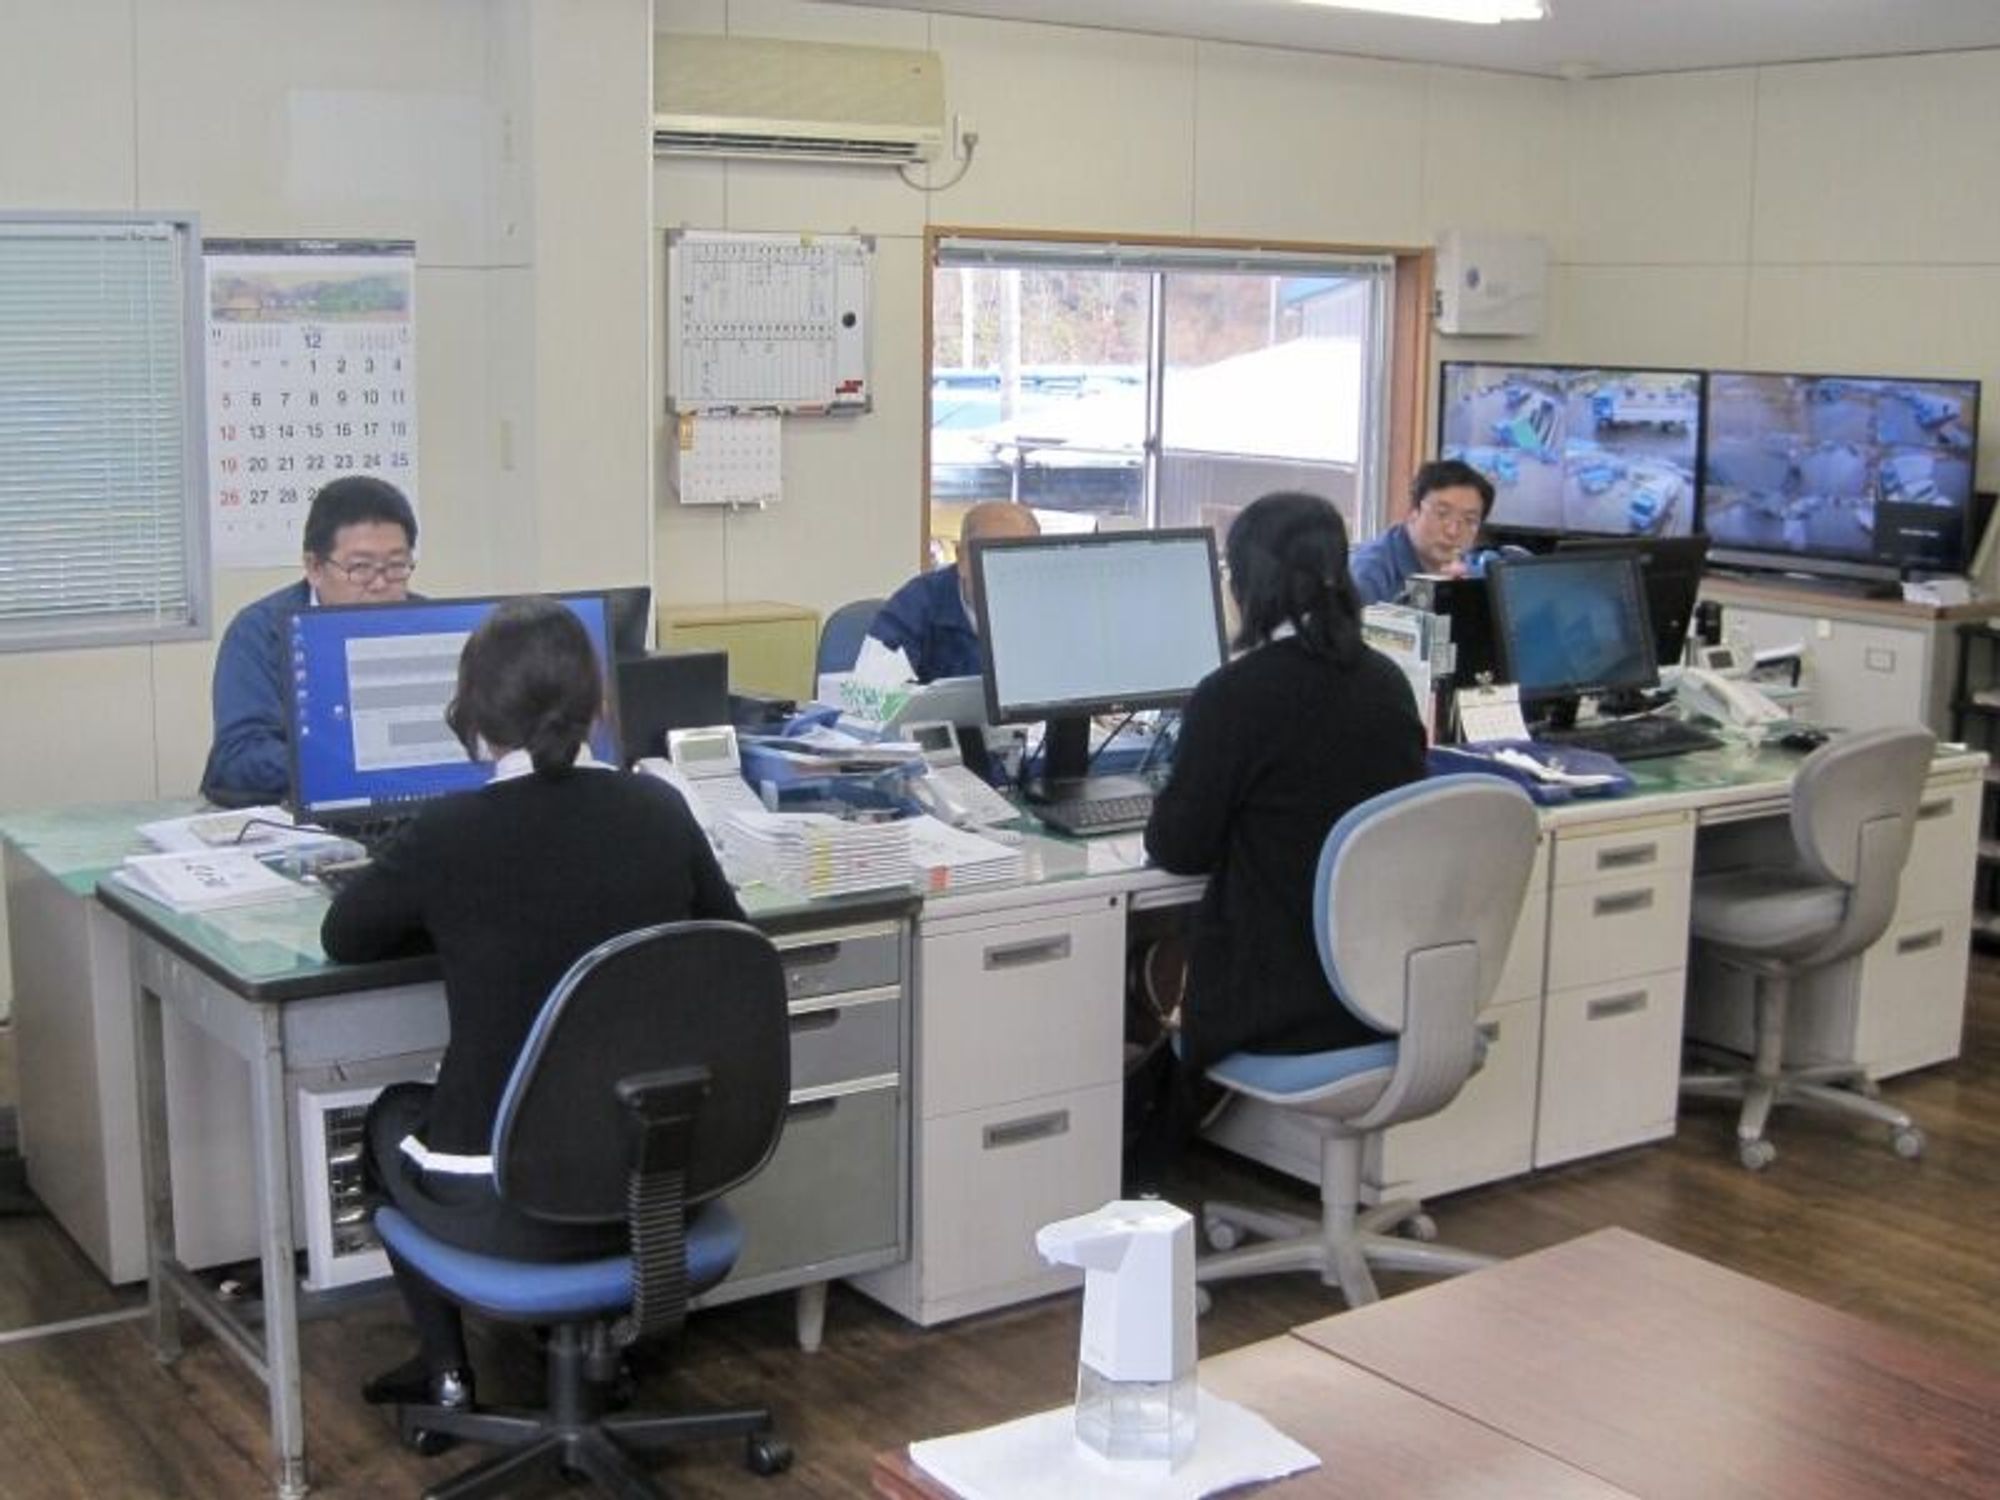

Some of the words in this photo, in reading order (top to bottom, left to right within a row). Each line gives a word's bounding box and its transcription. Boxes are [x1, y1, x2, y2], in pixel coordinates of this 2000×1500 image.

[305, 333, 321, 349] 12
[309, 359, 316, 374] 1
[337, 358, 346, 373] 2
[365, 358, 374, 373] 3
[393, 358, 402, 371] 4
[223, 392, 231, 409] 5
[252, 392, 261, 406] 6
[280, 392, 290, 407] 7
[310, 391, 318, 406] 8
[337, 390, 346, 405] 9
[363, 389, 378, 404] 10
[392, 389, 404, 404] 11
[220, 426, 236, 441] 12
[249, 426, 265, 440] 13
[279, 425, 294, 439] 14
[307, 425, 323, 438] 15
[336, 423, 351, 437] 16
[364, 423, 378, 436] 17
[392, 422, 406, 437] 18
[220, 458, 236, 474] 19
[249, 457, 267, 472] 20
[279, 456, 294, 471] 21
[307, 455, 324, 470] 22
[335, 454, 353, 469] 23
[363, 454, 381, 468] 24
[391, 453, 409, 467] 25
[220, 490, 239, 506] 26
[250, 490, 268, 504] 27
[279, 489, 298, 504] 28
